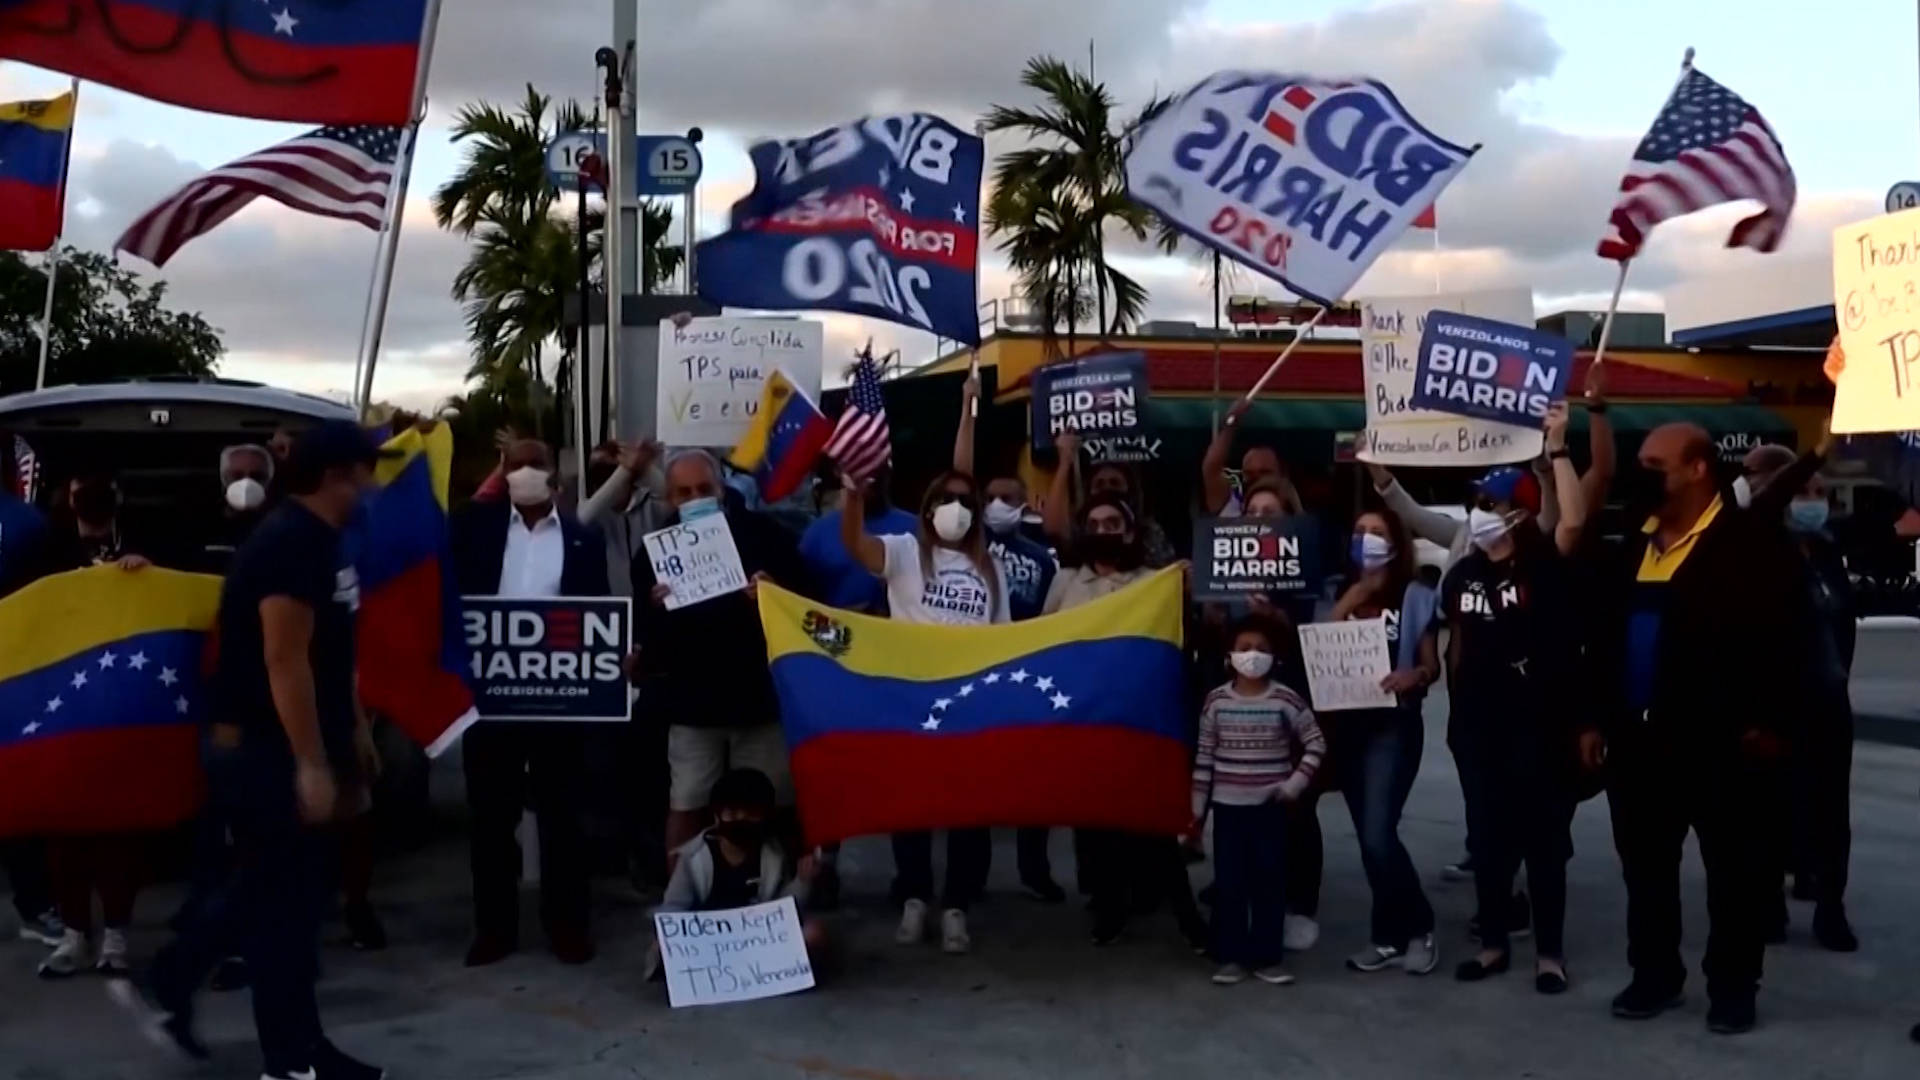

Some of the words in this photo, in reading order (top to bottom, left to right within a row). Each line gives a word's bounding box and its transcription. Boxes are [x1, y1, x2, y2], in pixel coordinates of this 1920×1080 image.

[660, 149, 688, 172] 15
[1896, 193, 1917, 209] 14
[1436, 323, 1531, 351] VENEZOLANOS
[679, 355, 722, 382] TPS
[1049, 385, 1136, 415] BIDEN
[1423, 373, 1550, 418] HARRIS
[1050, 409, 1138, 435] HARRIS
[1457, 426, 1513, 452] Biden
[650, 521, 699, 555] TPS
[1214, 526, 1258, 536] WOMEN
[655, 555, 684, 577] 48
[1212, 559, 1301, 577] HARRIS
[921, 595, 986, 617] HARRIS
[924, 582, 988, 604] BIDEN
[1460, 586, 1518, 615] BIN
[462, 610, 621, 647] BIDEN
[485, 684, 590, 697] JOEBIDEN.COM
[664, 938, 702, 959] his
[678, 964, 739, 997] TPS
